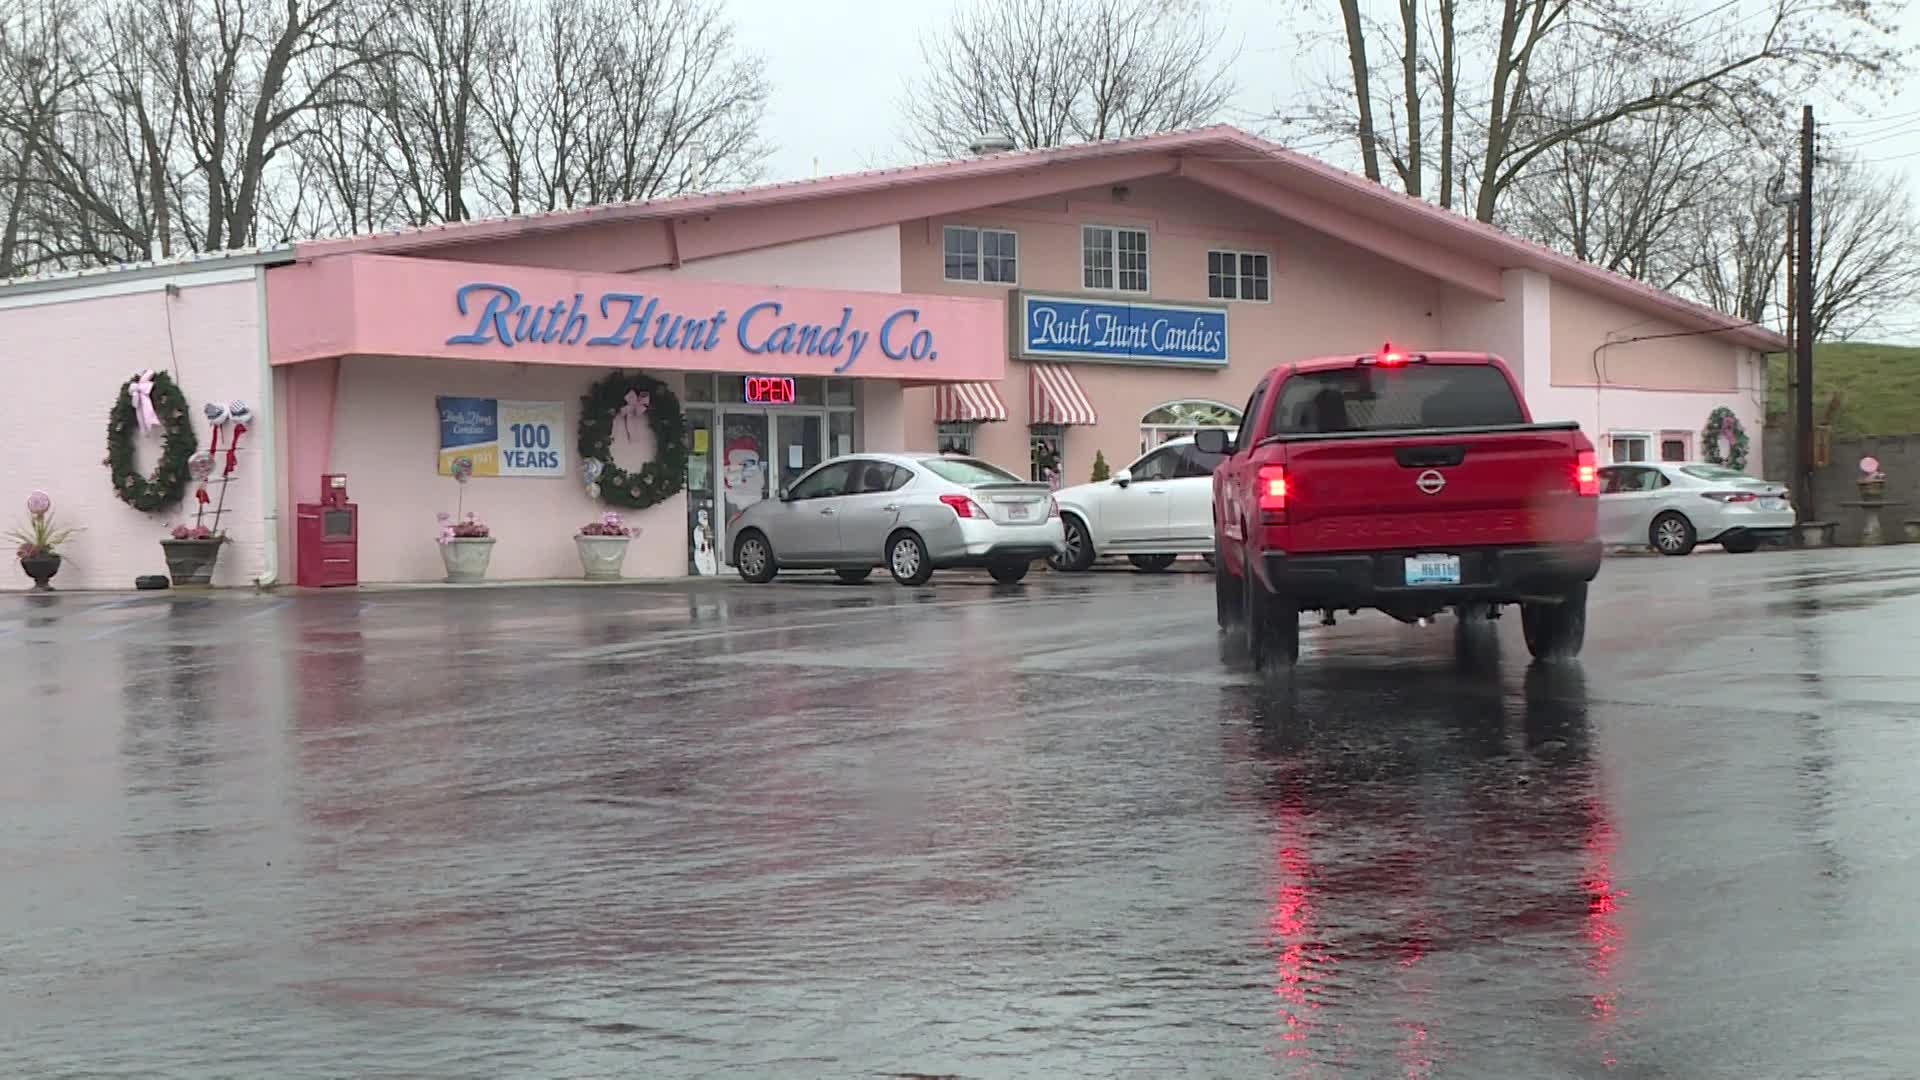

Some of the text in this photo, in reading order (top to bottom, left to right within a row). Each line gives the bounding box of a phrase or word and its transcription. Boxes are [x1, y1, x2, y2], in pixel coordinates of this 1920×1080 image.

[446, 282, 938, 373] Ruth Hunt Candy Co.
[1032, 307, 1222, 353] Ruth Hunt Candies
[746, 378, 793, 401] OPEN
[510, 423, 550, 449] 100
[503, 450, 558, 469] YEARS
